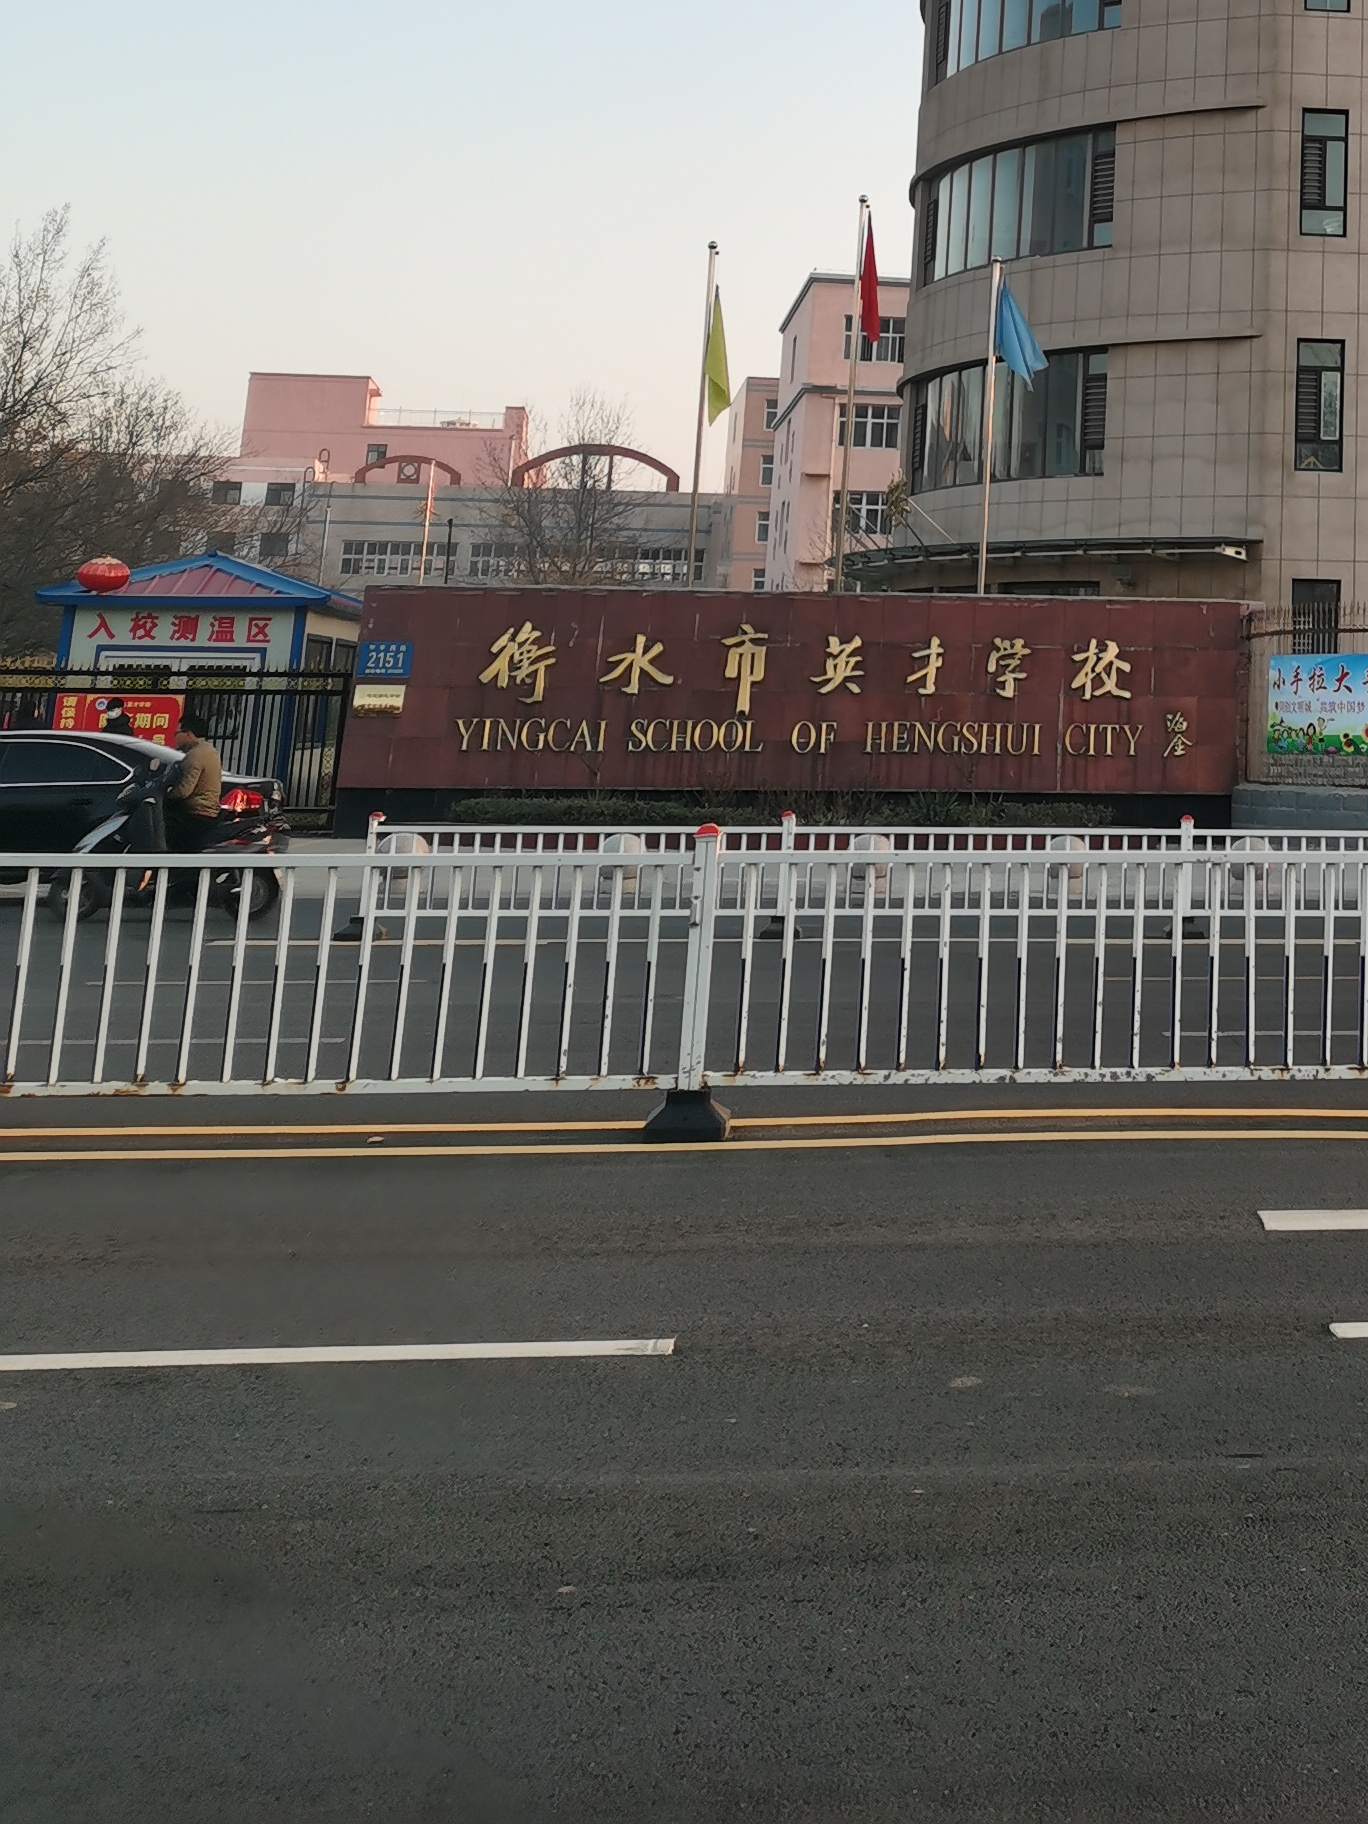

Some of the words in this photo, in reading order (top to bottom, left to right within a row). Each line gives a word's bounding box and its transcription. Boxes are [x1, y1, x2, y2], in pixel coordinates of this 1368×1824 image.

[87, 611, 273, 643] 入校测温区
[366, 651, 404, 668] 2151
[478, 620, 1132, 716] 衡水市英才学校
[455, 717, 608, 754] YINGCAI
[627, 717, 764, 753] SCHOOL
[790, 720, 838, 755] OF
[862, 721, 1043, 756] HENGSHUI
[1064, 723, 1146, 757] CITY
